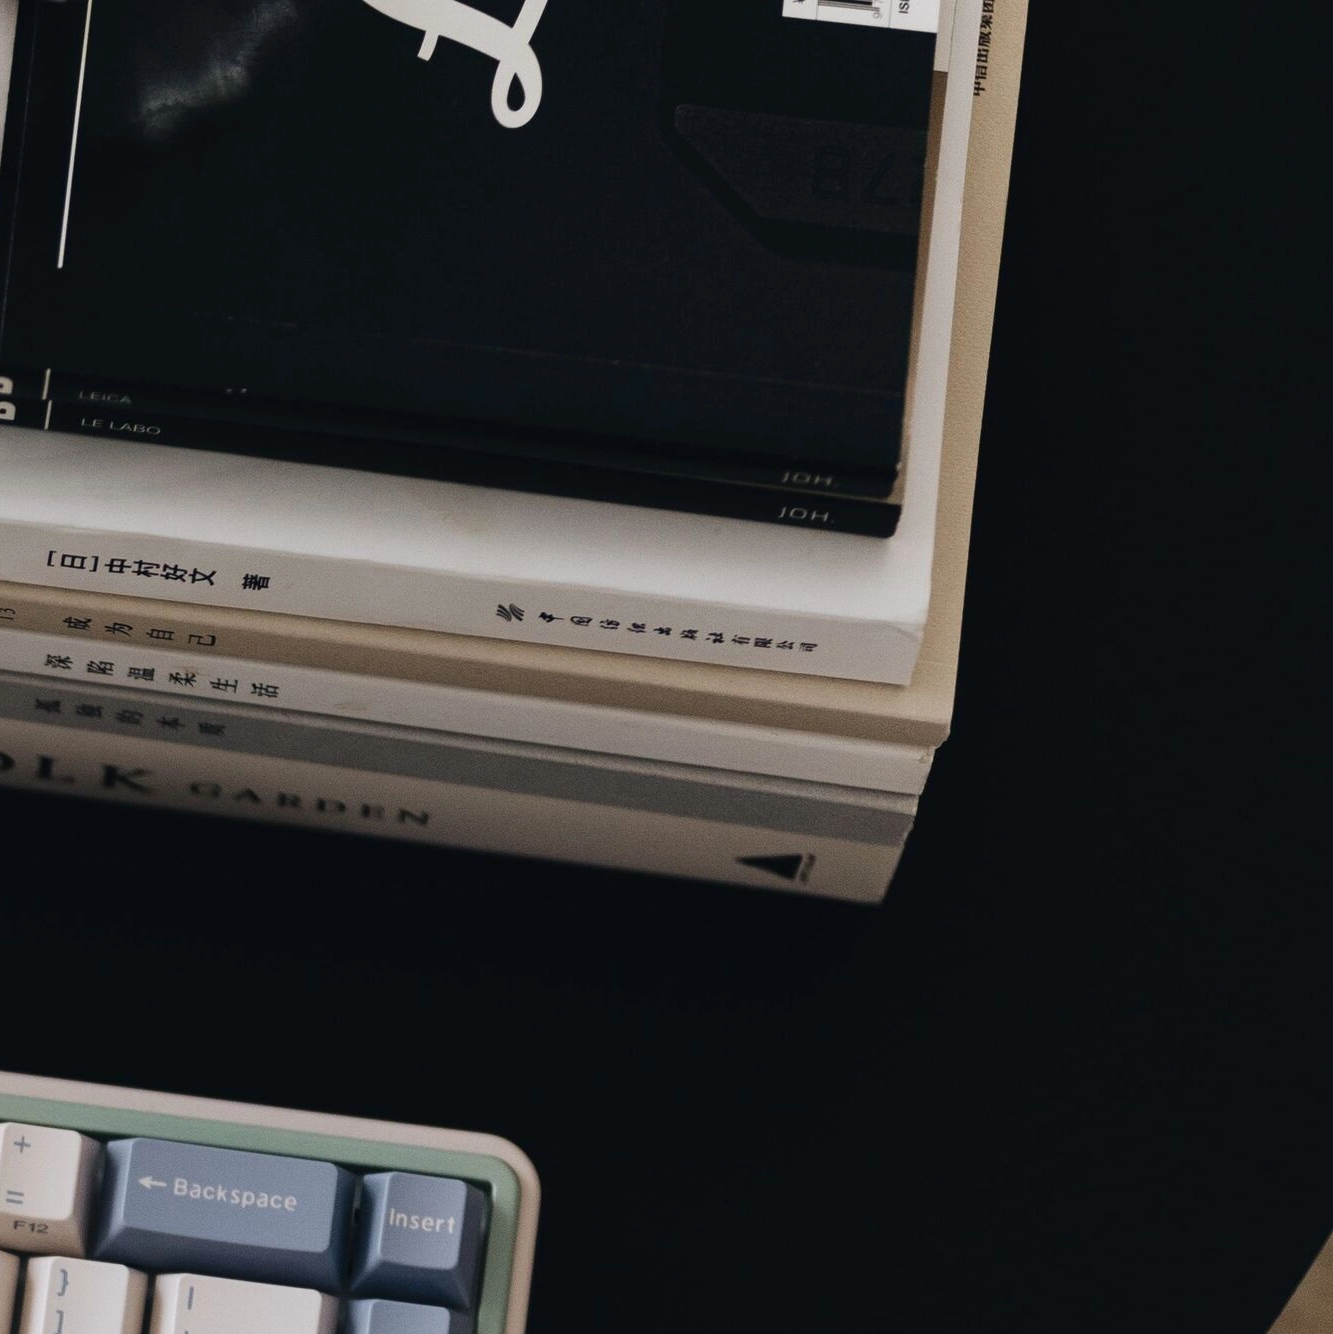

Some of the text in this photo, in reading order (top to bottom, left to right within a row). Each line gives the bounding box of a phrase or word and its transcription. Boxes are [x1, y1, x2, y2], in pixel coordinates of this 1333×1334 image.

[78, 391, 131, 404] LEICA
[81, 418, 161, 434] LE LABO
[242, 574, 270, 590] 著
[61, 616, 218, 648] 成为自己
[44, 653, 280, 698] 深陷温柔生活
[188, 780, 430, 826] GARDEN
[14, 1136, 31, 1153] +
[6, 1190, 24, 1204] =
[173, 1178, 297, 1211] Backspace
[13, 1219, 49, 1234] F12
[389, 1208, 455, 1234] Insert
[57, 1269, 69, 1297] }
